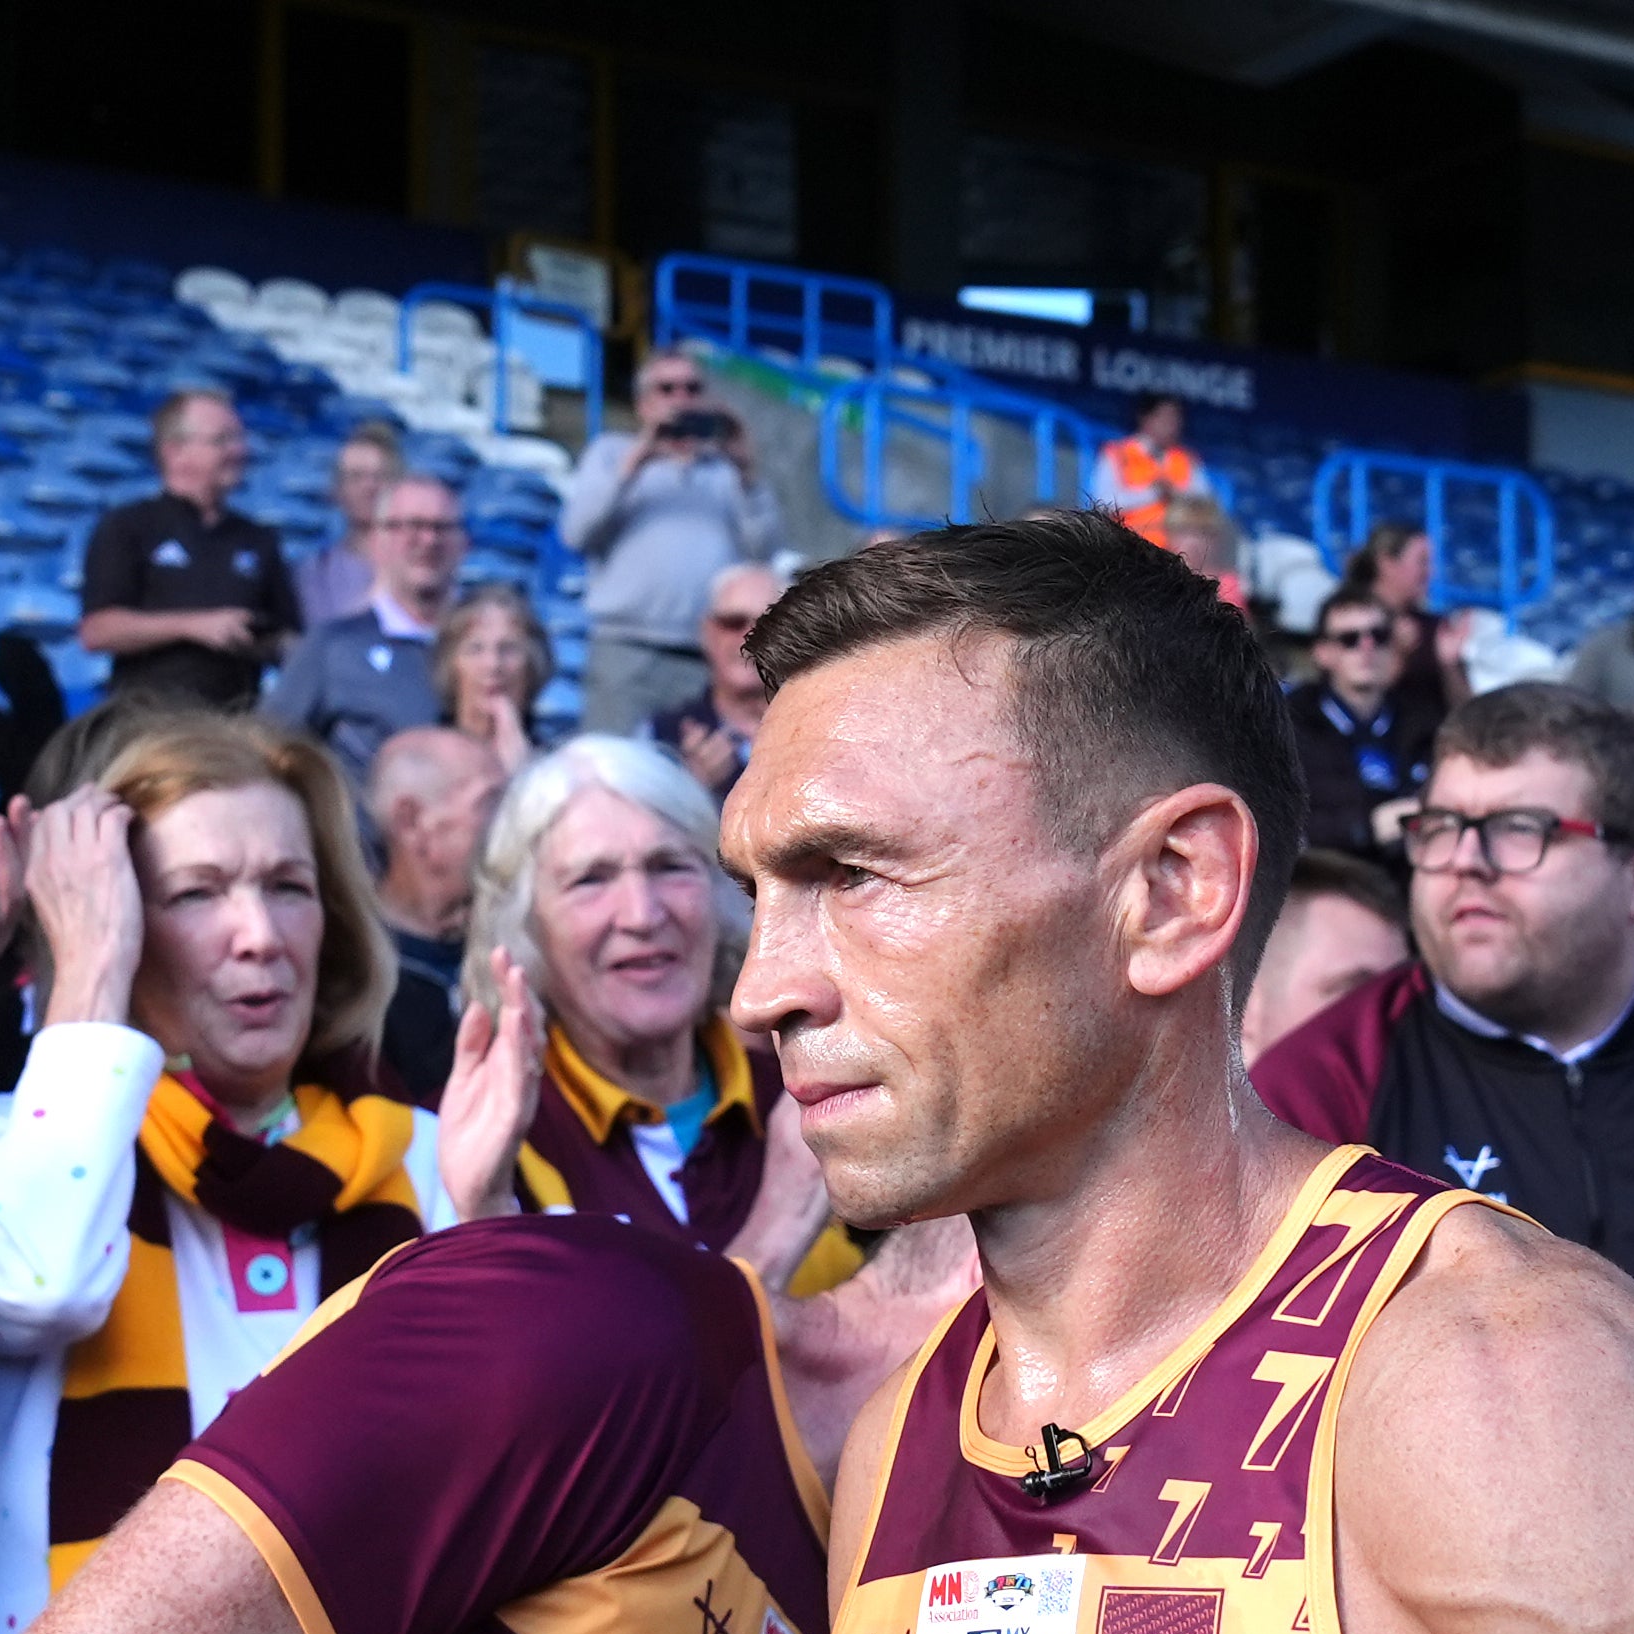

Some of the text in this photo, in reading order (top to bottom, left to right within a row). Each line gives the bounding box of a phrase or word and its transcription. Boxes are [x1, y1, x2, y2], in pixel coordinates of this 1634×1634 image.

[902, 320, 1253, 409] PREMIER LOUNGE
[1240, 1350, 1337, 1471] 7
[1091, 1445, 1131, 1493] 7
[1149, 1478, 1213, 1566] 7
[1242, 1521, 1282, 1579] 7
[928, 1571, 980, 1608] MND
[928, 1609, 979, 1624] Association
